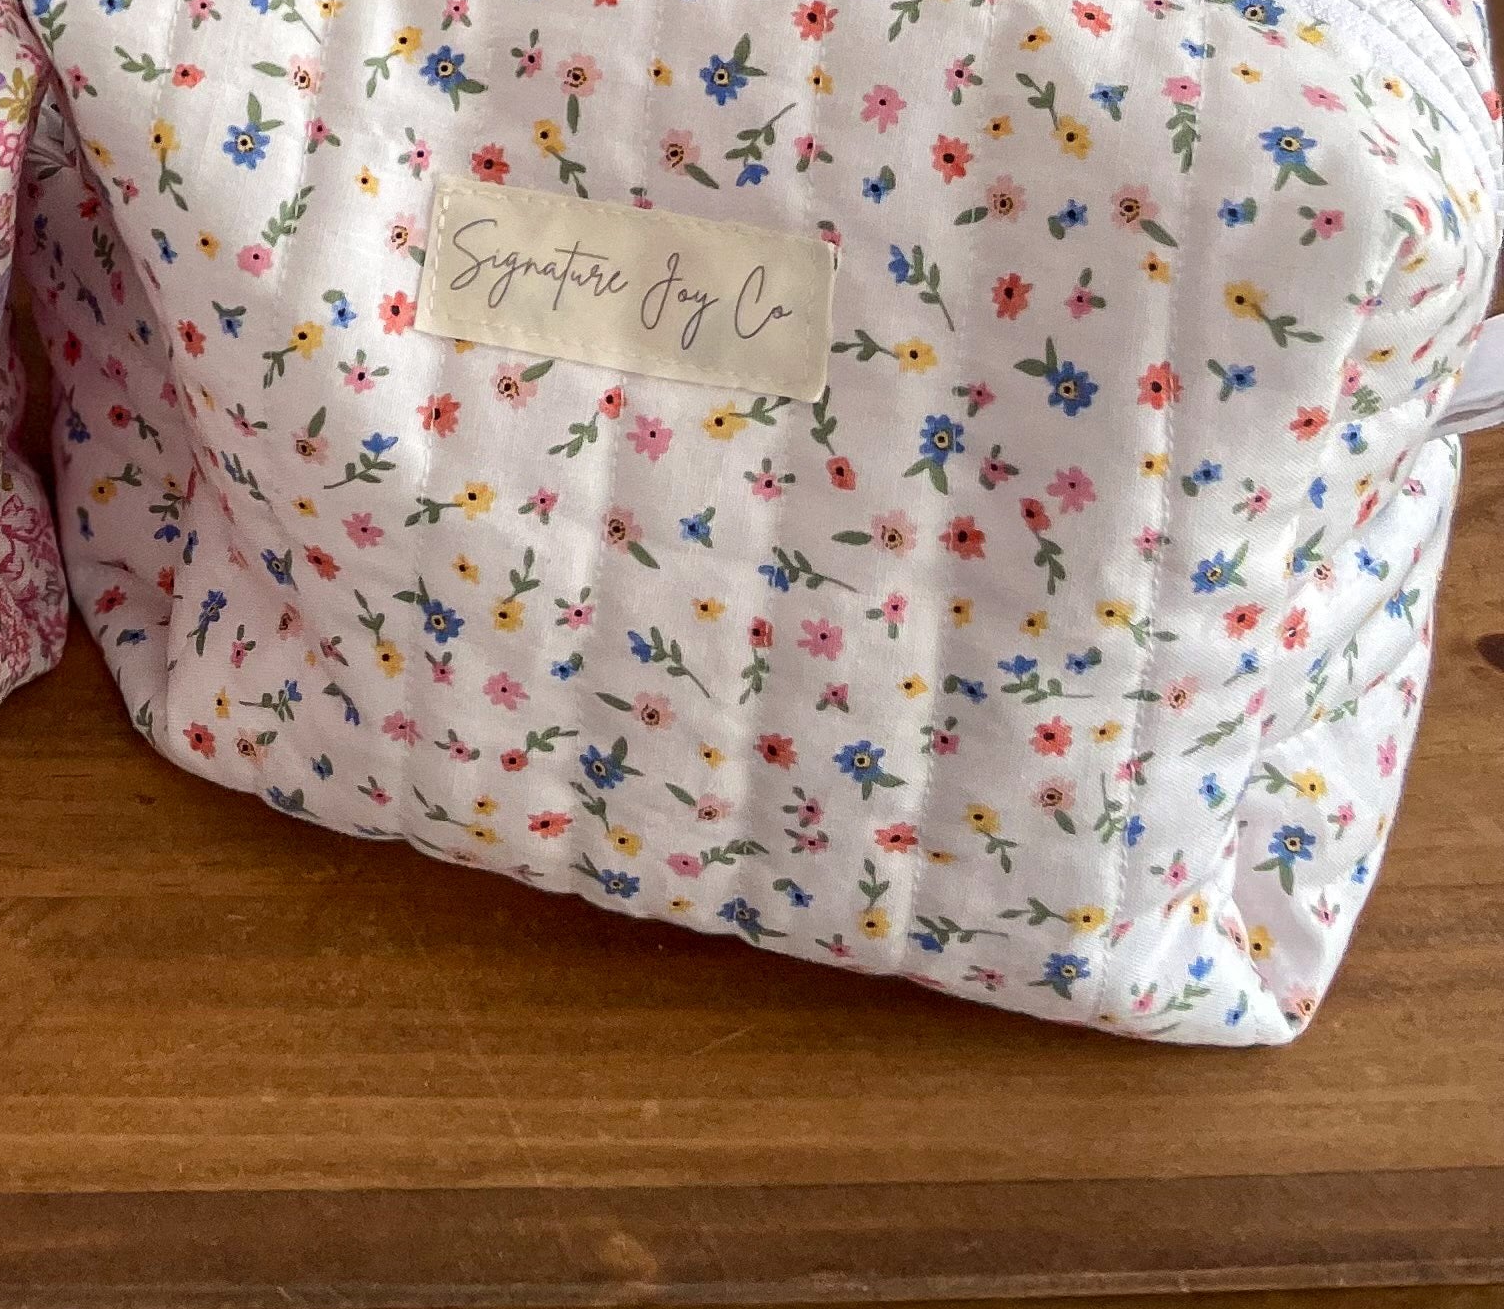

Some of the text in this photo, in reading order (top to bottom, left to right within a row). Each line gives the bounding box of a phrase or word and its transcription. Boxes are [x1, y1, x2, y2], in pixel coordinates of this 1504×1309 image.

[449, 218, 793, 350] Signature Joy Co
